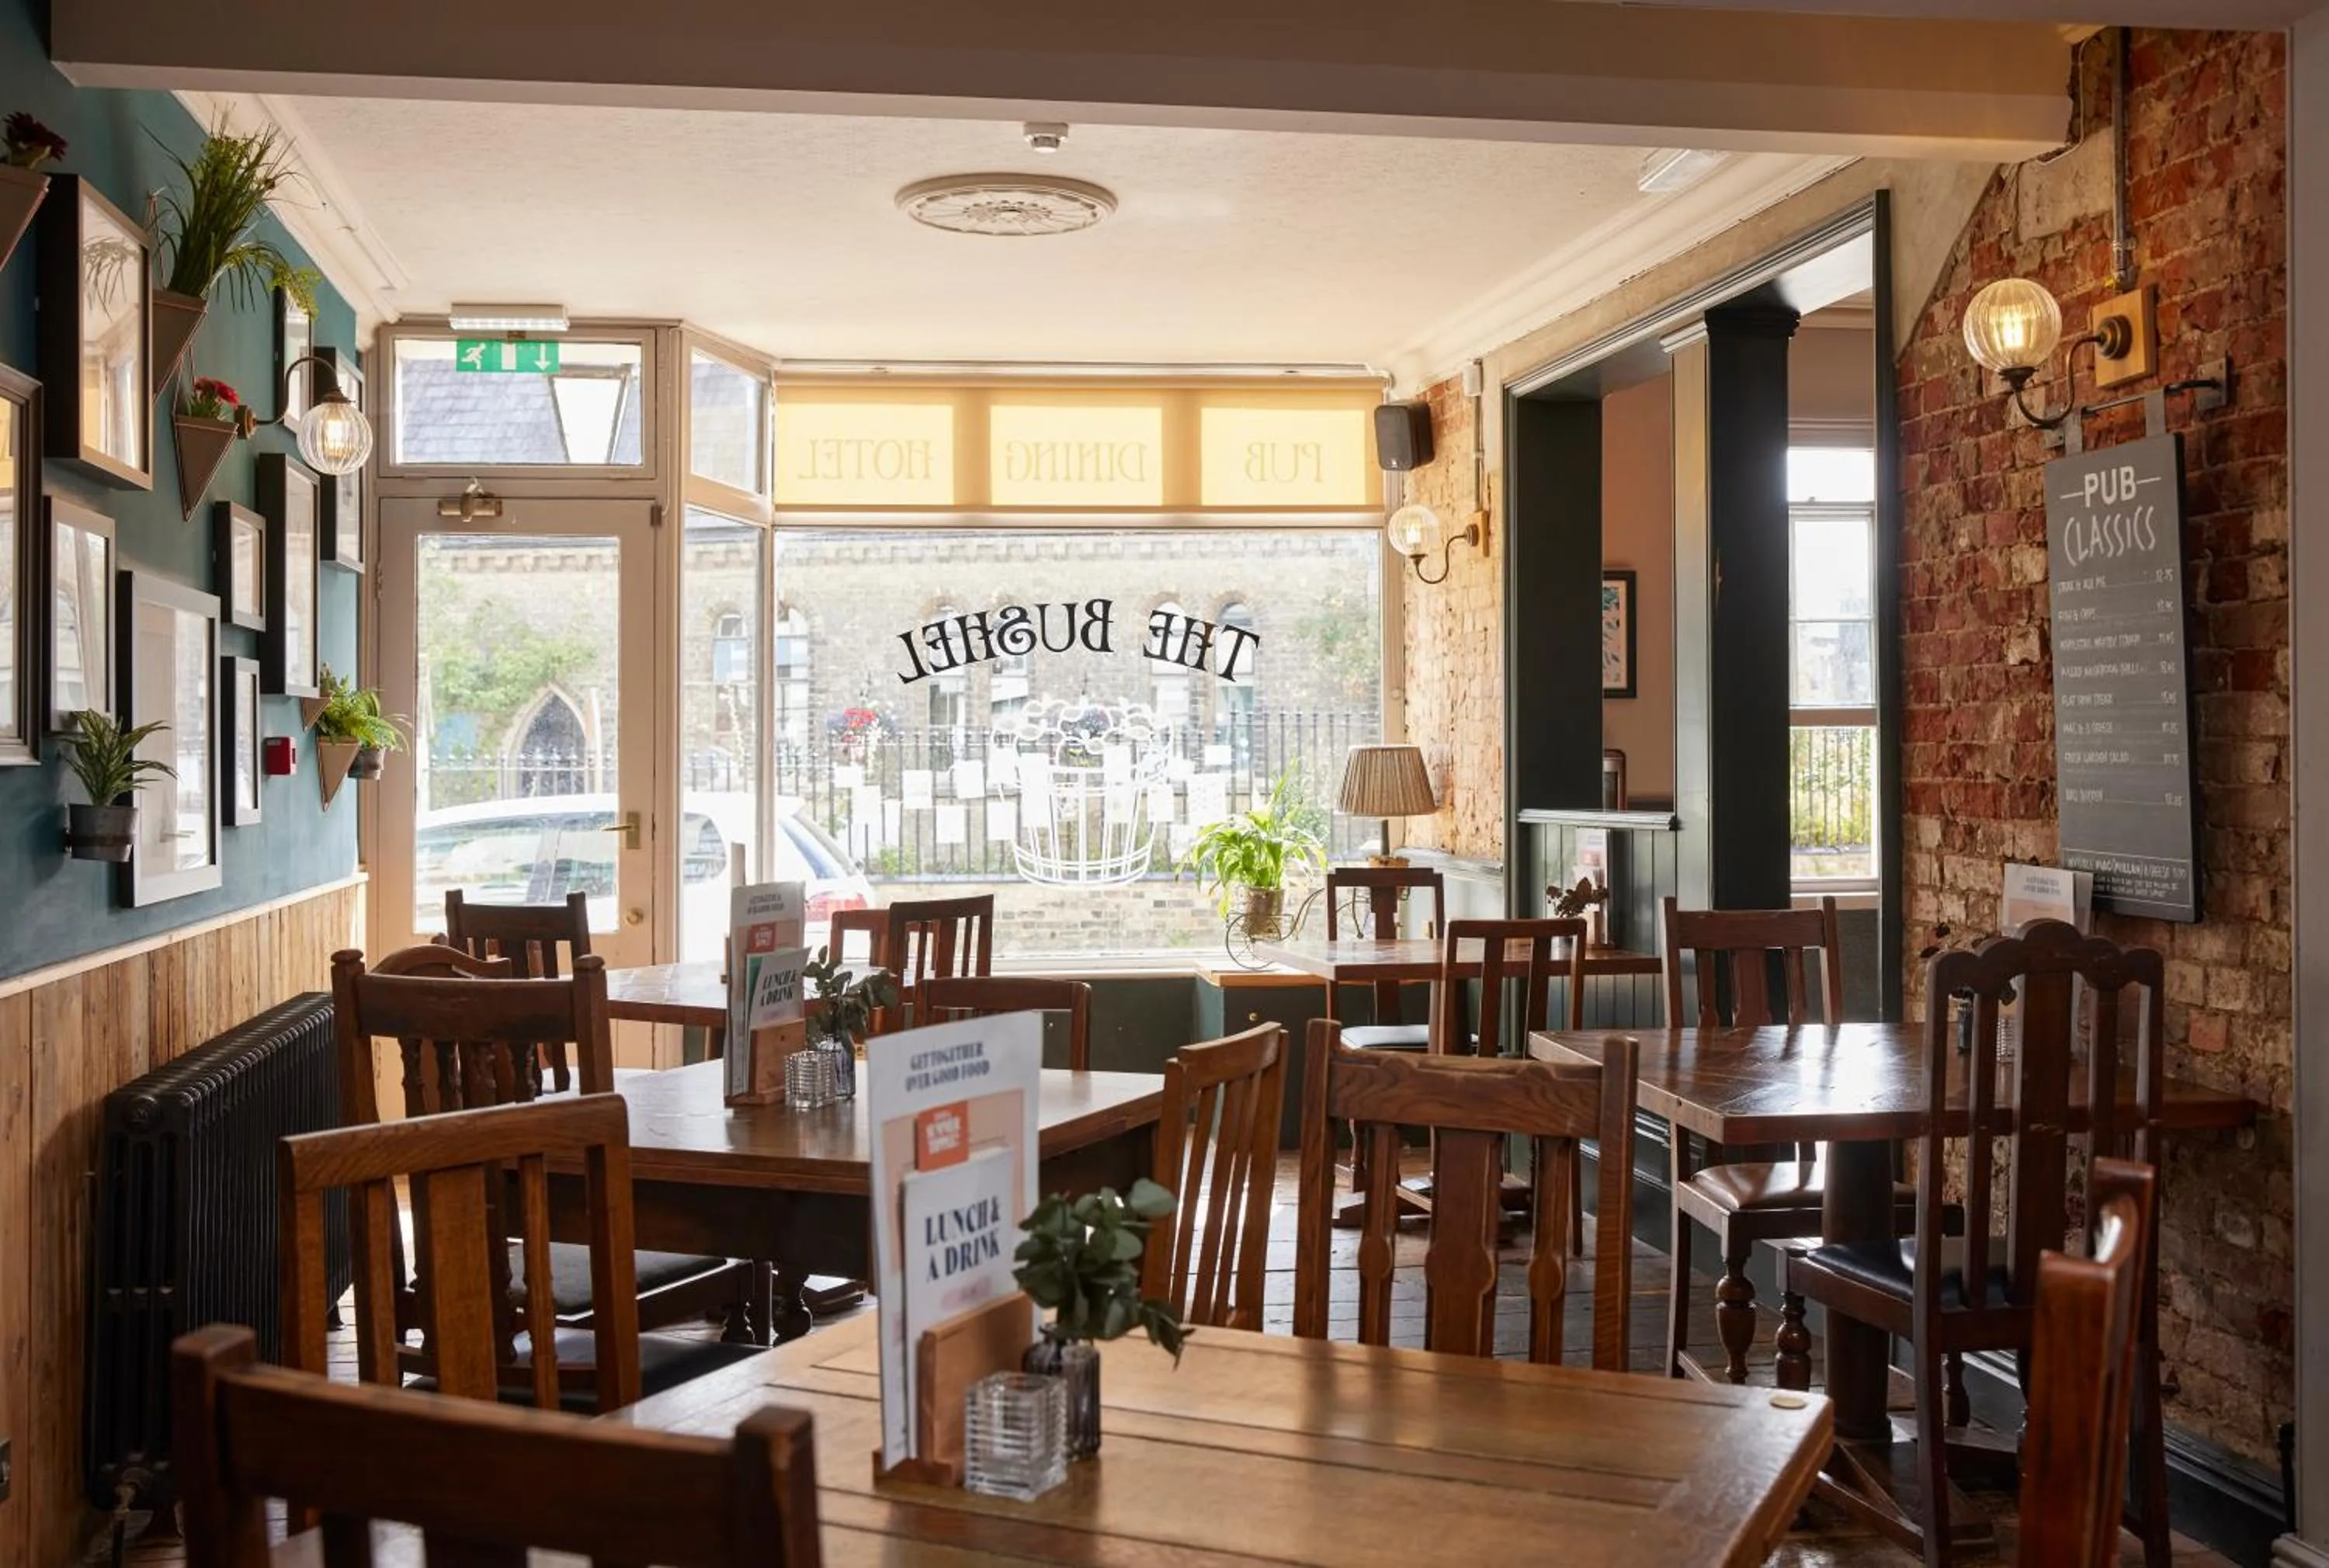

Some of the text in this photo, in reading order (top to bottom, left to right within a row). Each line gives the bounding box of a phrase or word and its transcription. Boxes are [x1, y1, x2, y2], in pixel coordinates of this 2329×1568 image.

[2084, 466, 2136, 508] PUB
[2063, 506, 2156, 567] CLASSICS
[925, 1199, 988, 1245] LUNCH
[926, 1226, 1000, 1283] A DRINK
